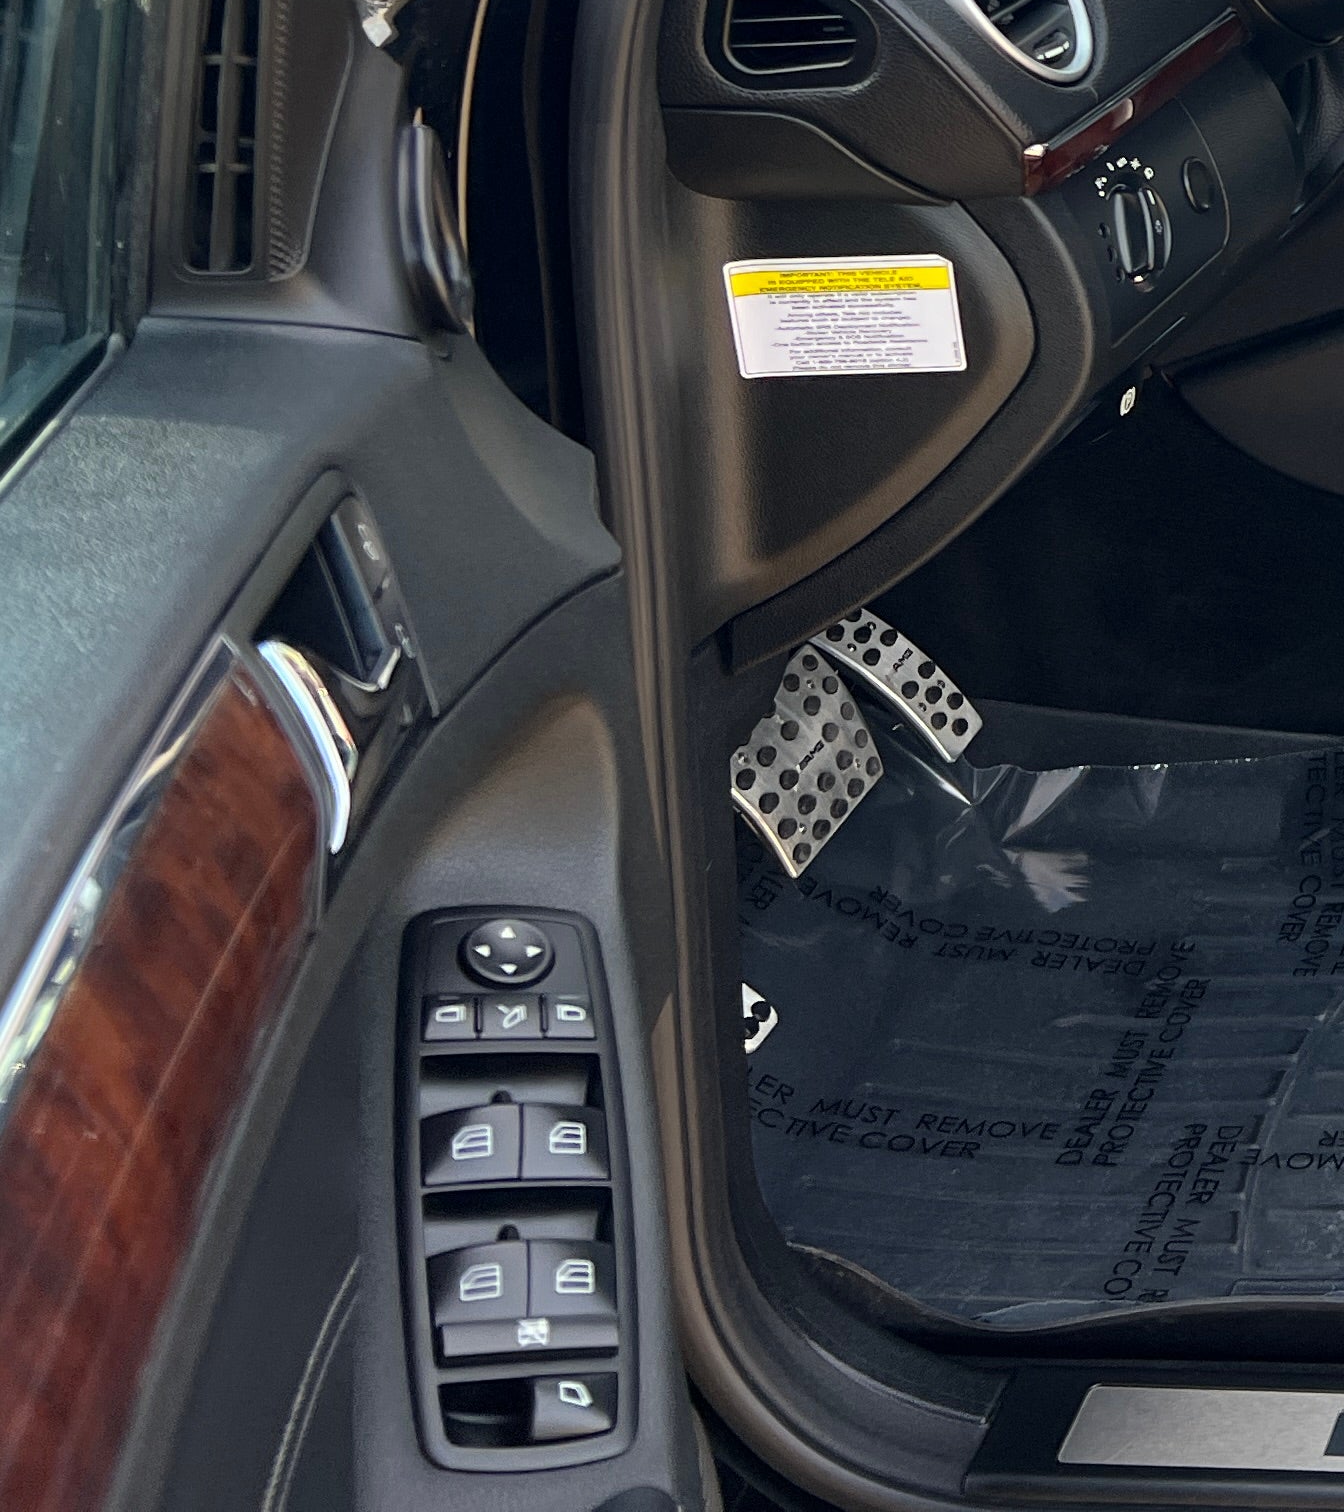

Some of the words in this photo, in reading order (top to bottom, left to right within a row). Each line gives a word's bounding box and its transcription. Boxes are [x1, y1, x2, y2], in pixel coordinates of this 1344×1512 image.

[931, 939, 1018, 962] MUST
[973, 924, 1157, 956] PROTECTIVE
[1031, 949, 1147, 977] DEALER
[1055, 1087, 1121, 1166] DEALER
[1103, 1030, 1150, 1078] MUST
[1092, 1047, 1176, 1167] PROTECTIVE
[1159, 978, 1212, 1043] COVER
[807, 1097, 902, 1127] MUST
[913, 1112, 1062, 1141] REMOVE
[857, 1131, 982, 1160] COVER
[1185, 1125, 1244, 1205] DEALER
[1124, 1123, 1209, 1254] PROTECTIVE
[1152, 1218, 1201, 1276] MUST
